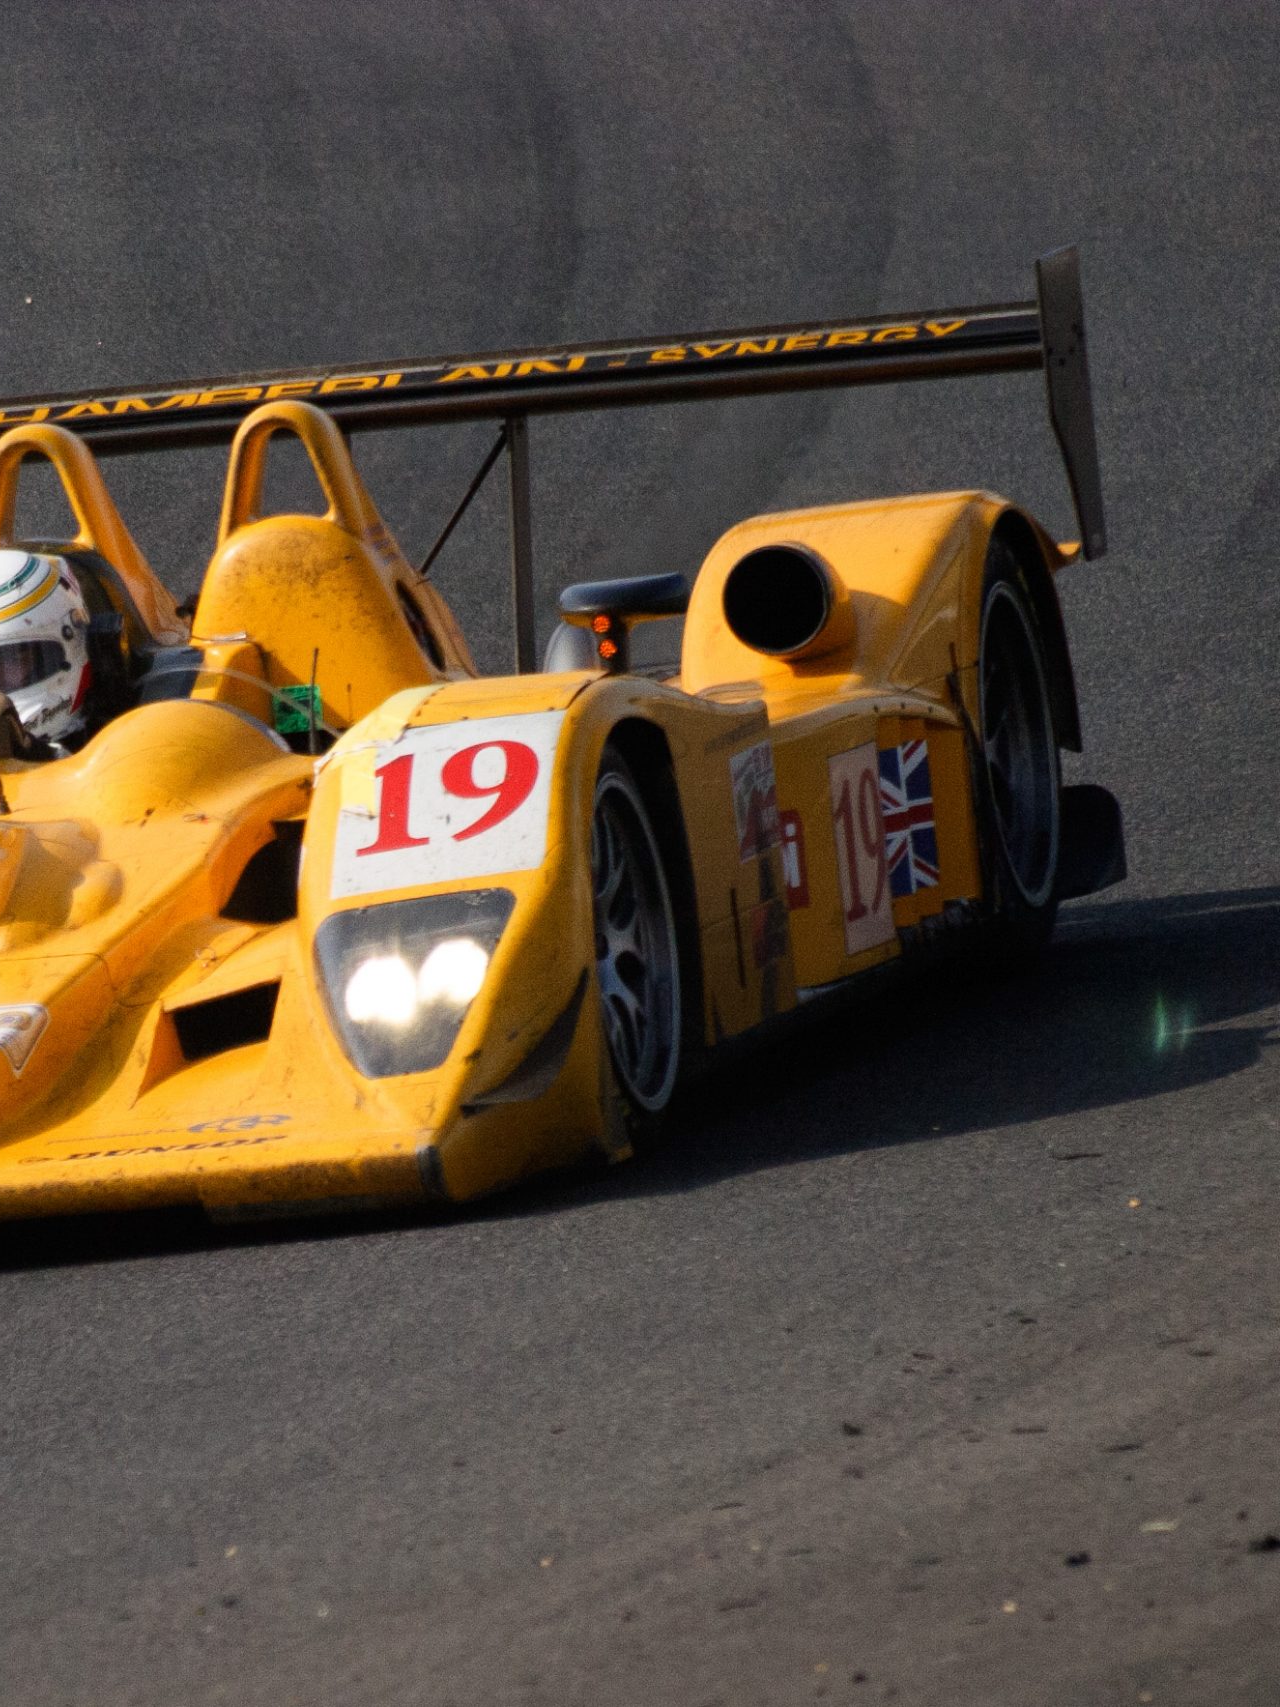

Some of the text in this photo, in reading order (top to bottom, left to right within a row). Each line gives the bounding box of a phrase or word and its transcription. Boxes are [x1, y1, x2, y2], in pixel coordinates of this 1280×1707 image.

[646, 319, 968, 366] SYNERGY
[356, 738, 540, 858] 19
[830, 766, 888, 924] 19
[59, 1134, 288, 1161] DUNLOP
